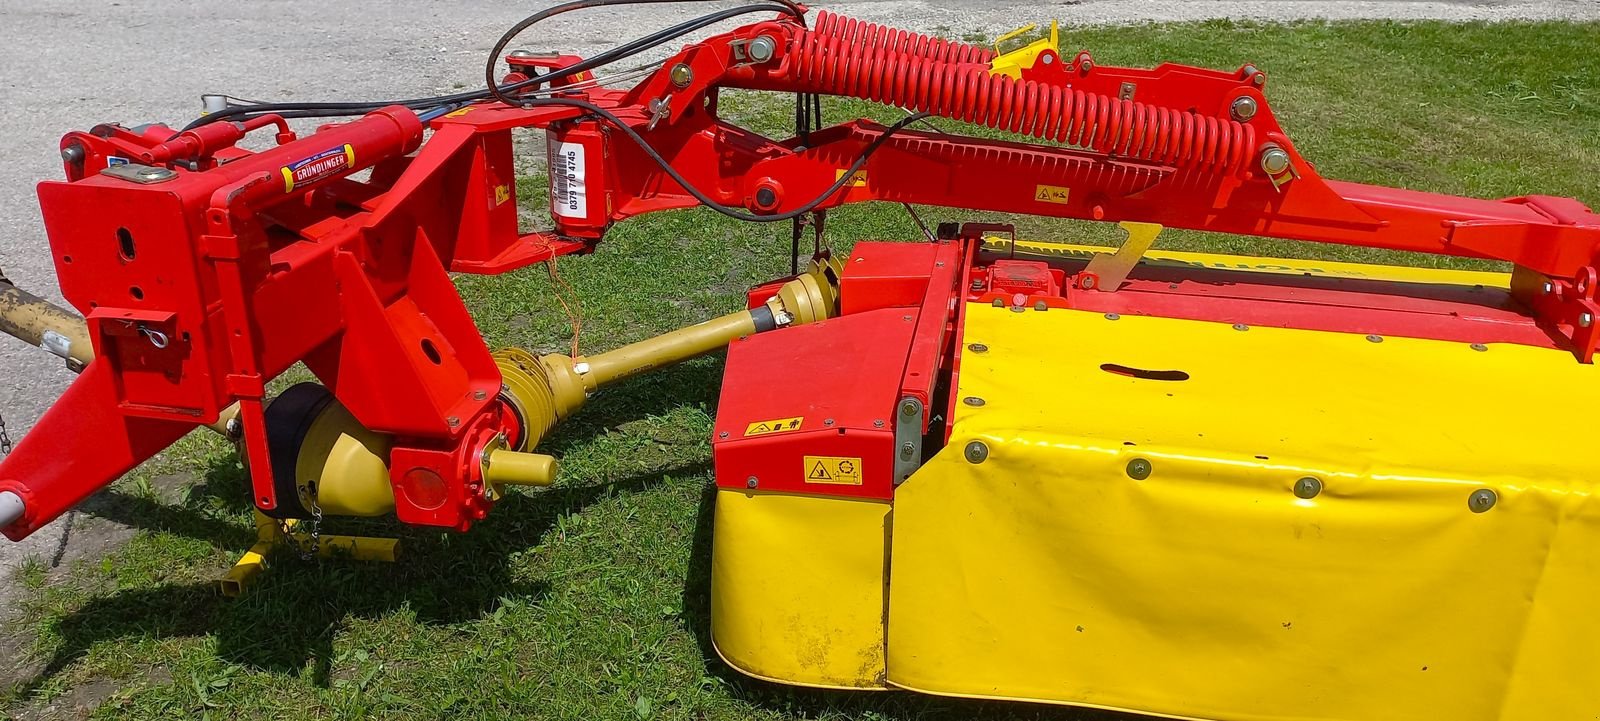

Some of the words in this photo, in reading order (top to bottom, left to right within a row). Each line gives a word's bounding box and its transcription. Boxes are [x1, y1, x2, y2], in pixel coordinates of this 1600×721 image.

[297, 154, 345, 181] GRÜNDLINGER
[568, 174, 576, 188] 710
[570, 191, 578, 210] 0379
